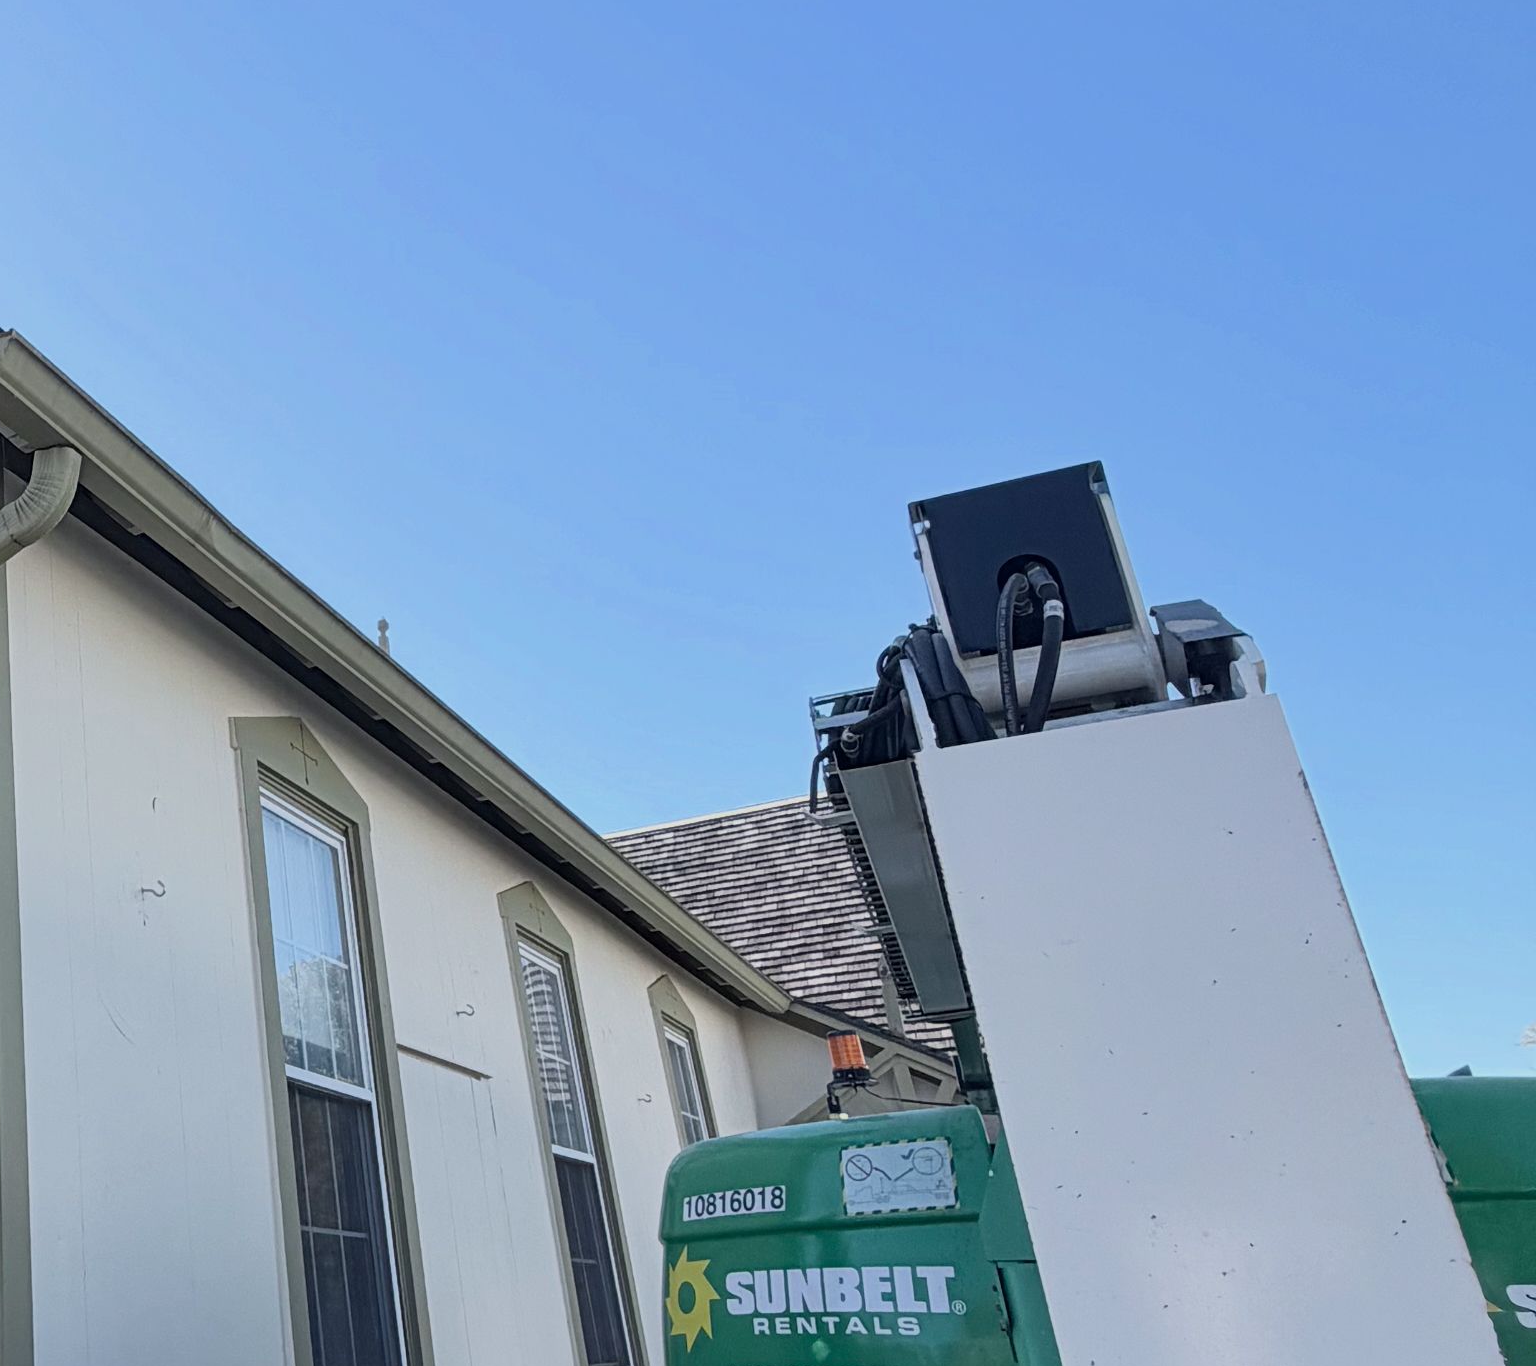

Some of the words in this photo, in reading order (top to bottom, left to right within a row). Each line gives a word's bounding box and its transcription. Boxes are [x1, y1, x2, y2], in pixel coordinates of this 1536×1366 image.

[684, 1186, 785, 1219] 10816018
[725, 1265, 956, 1315] SUNBELT
[752, 1316, 921, 1336] RENTALS
